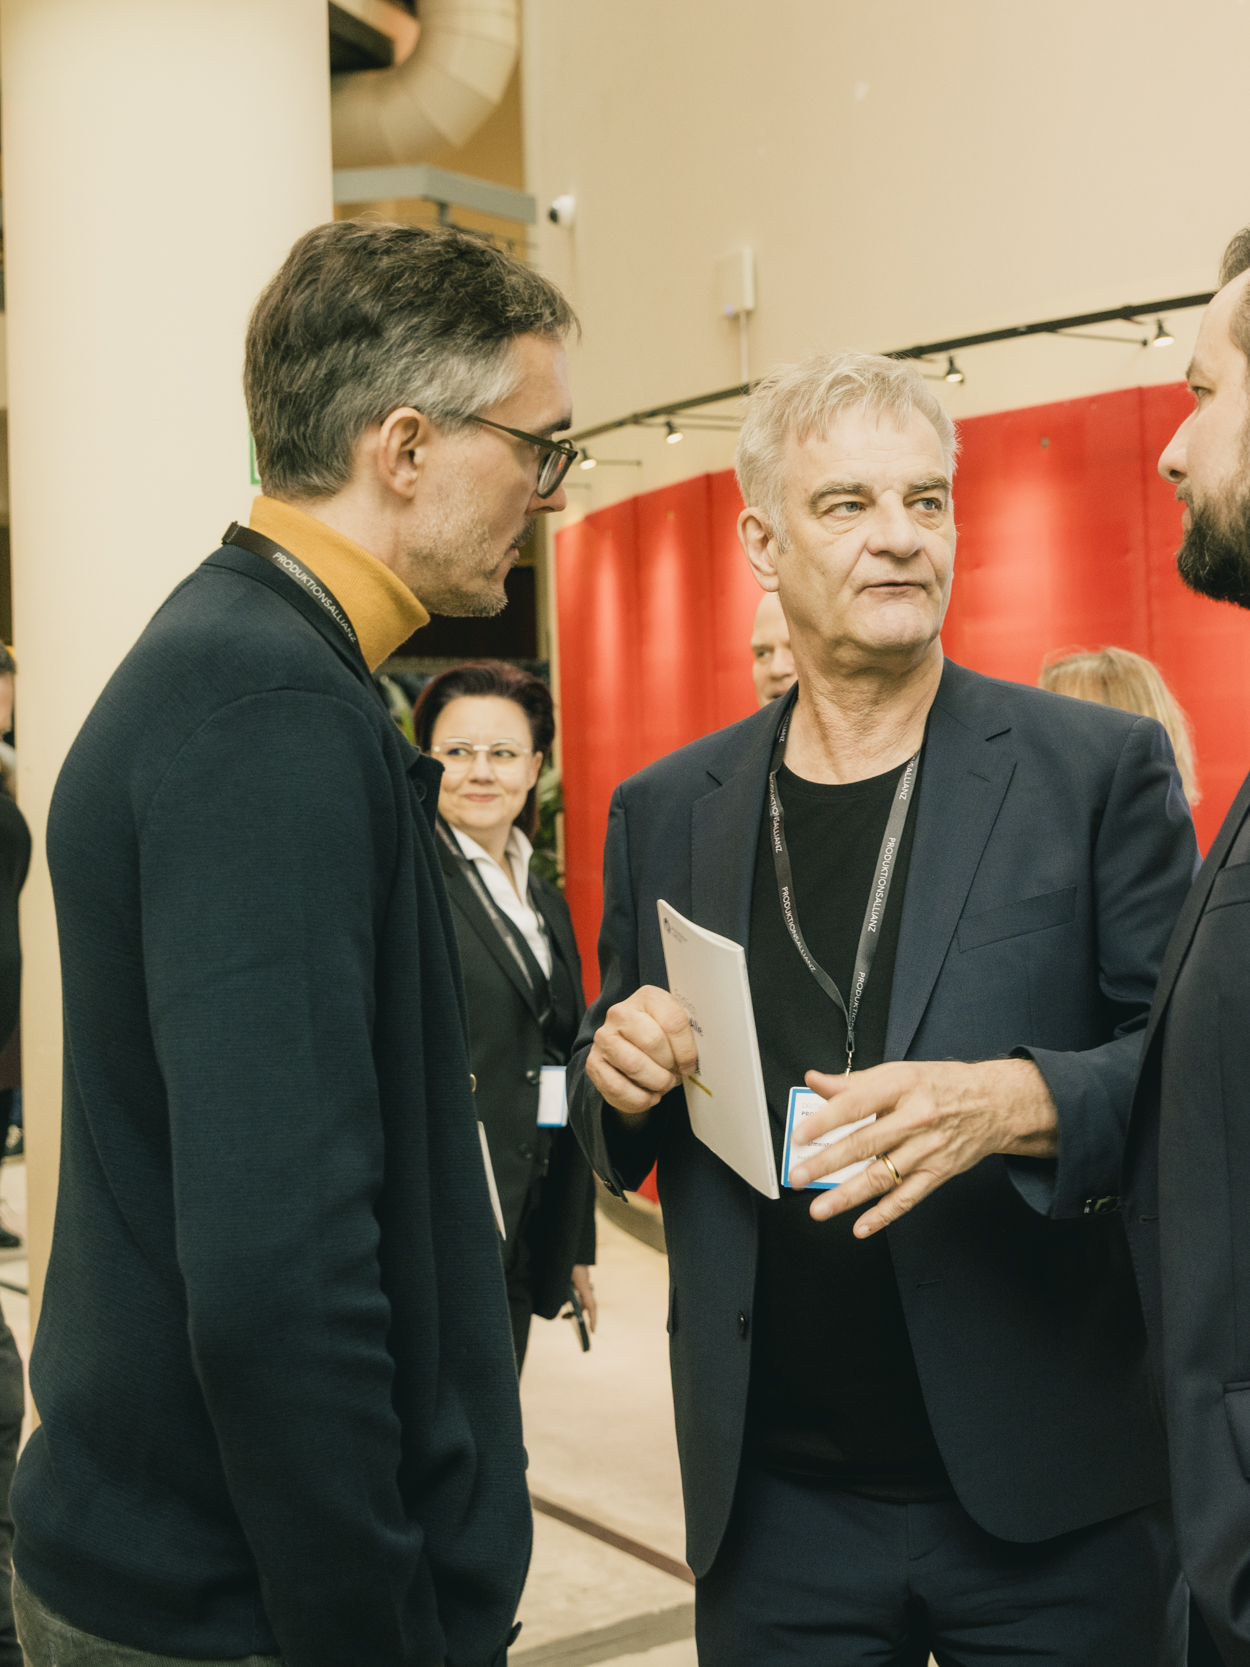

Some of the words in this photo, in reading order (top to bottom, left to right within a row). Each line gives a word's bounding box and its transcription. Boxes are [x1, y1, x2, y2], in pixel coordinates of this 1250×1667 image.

[272, 551, 357, 644] PRODUKTIONSALLIANZ
[781, 886, 817, 974] PRODUKTIONSALLIANZ
[867, 836, 897, 933] PRODUKTIONSALLIANZ
